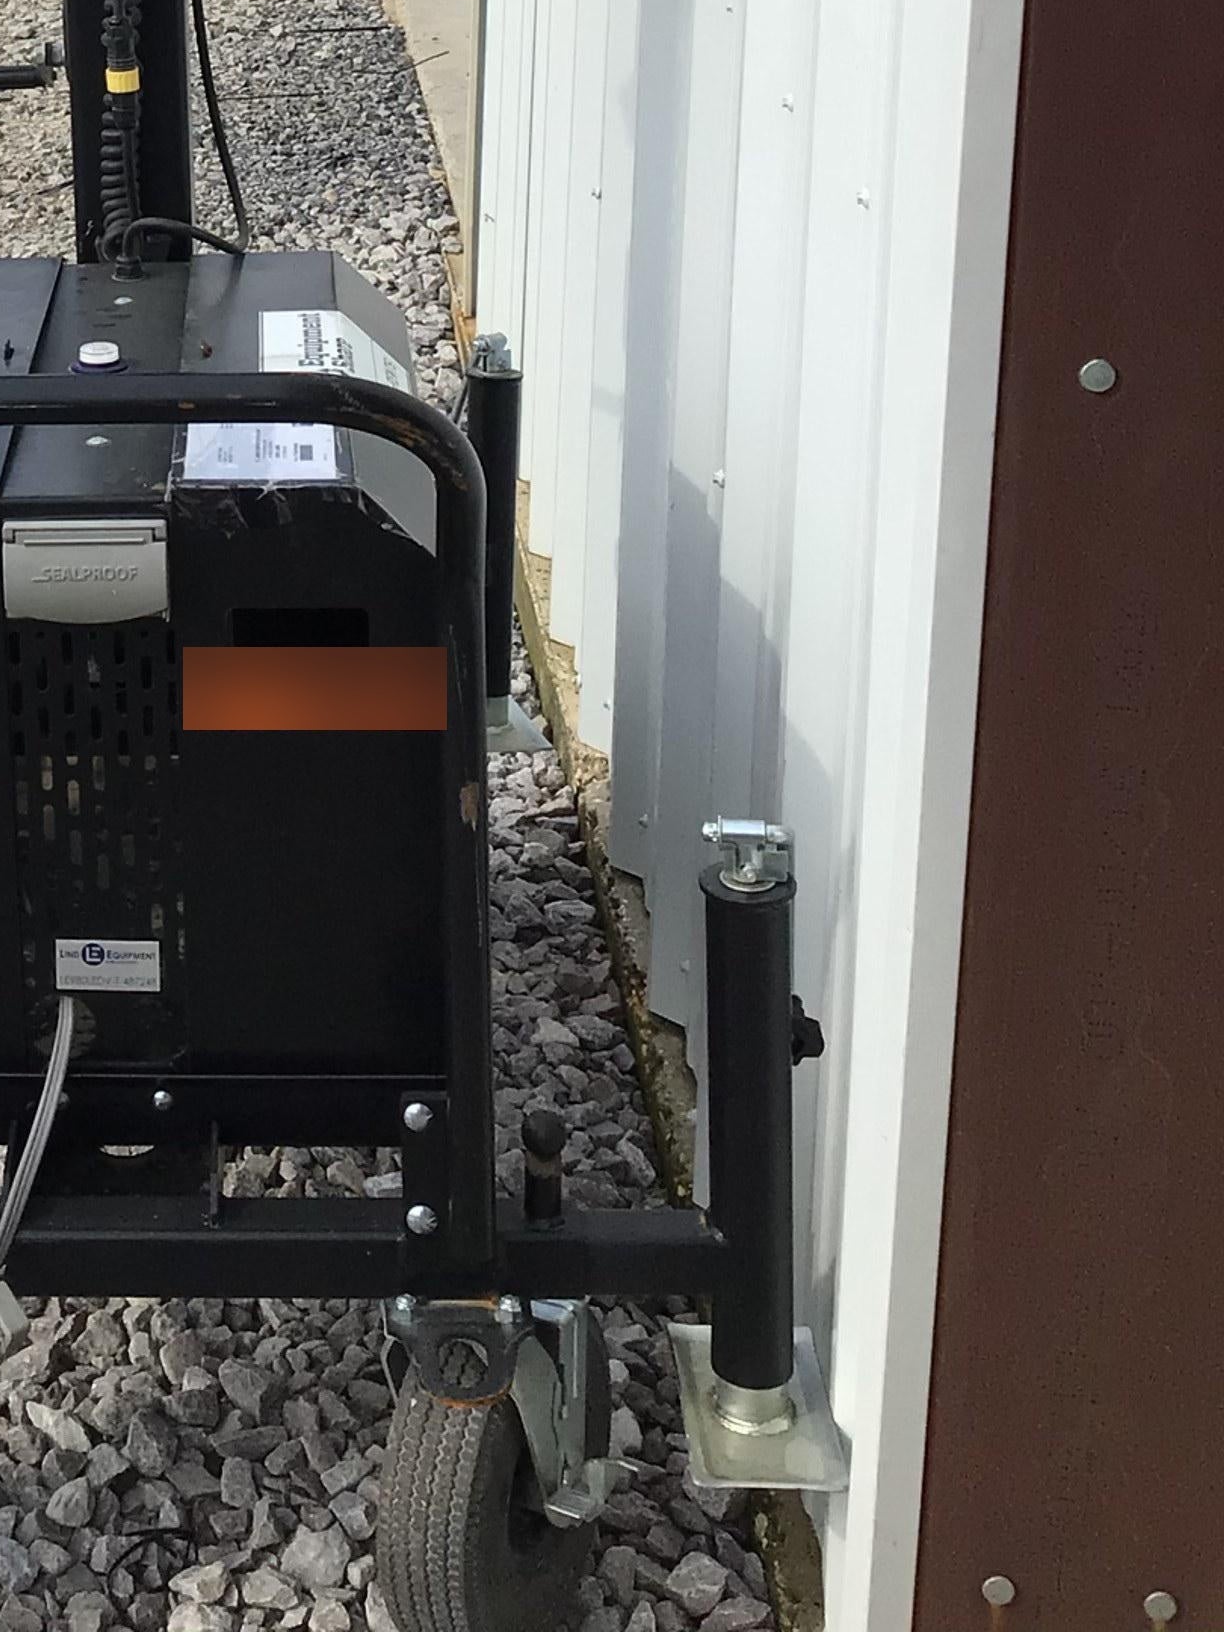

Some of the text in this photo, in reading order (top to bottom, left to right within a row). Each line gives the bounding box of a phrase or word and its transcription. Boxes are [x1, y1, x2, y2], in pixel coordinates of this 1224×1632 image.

[297, 312, 330, 367] Equipment
[31, 566, 138, 583] SEALPROOF
[107, 949, 156, 960] EQUIPMENT
